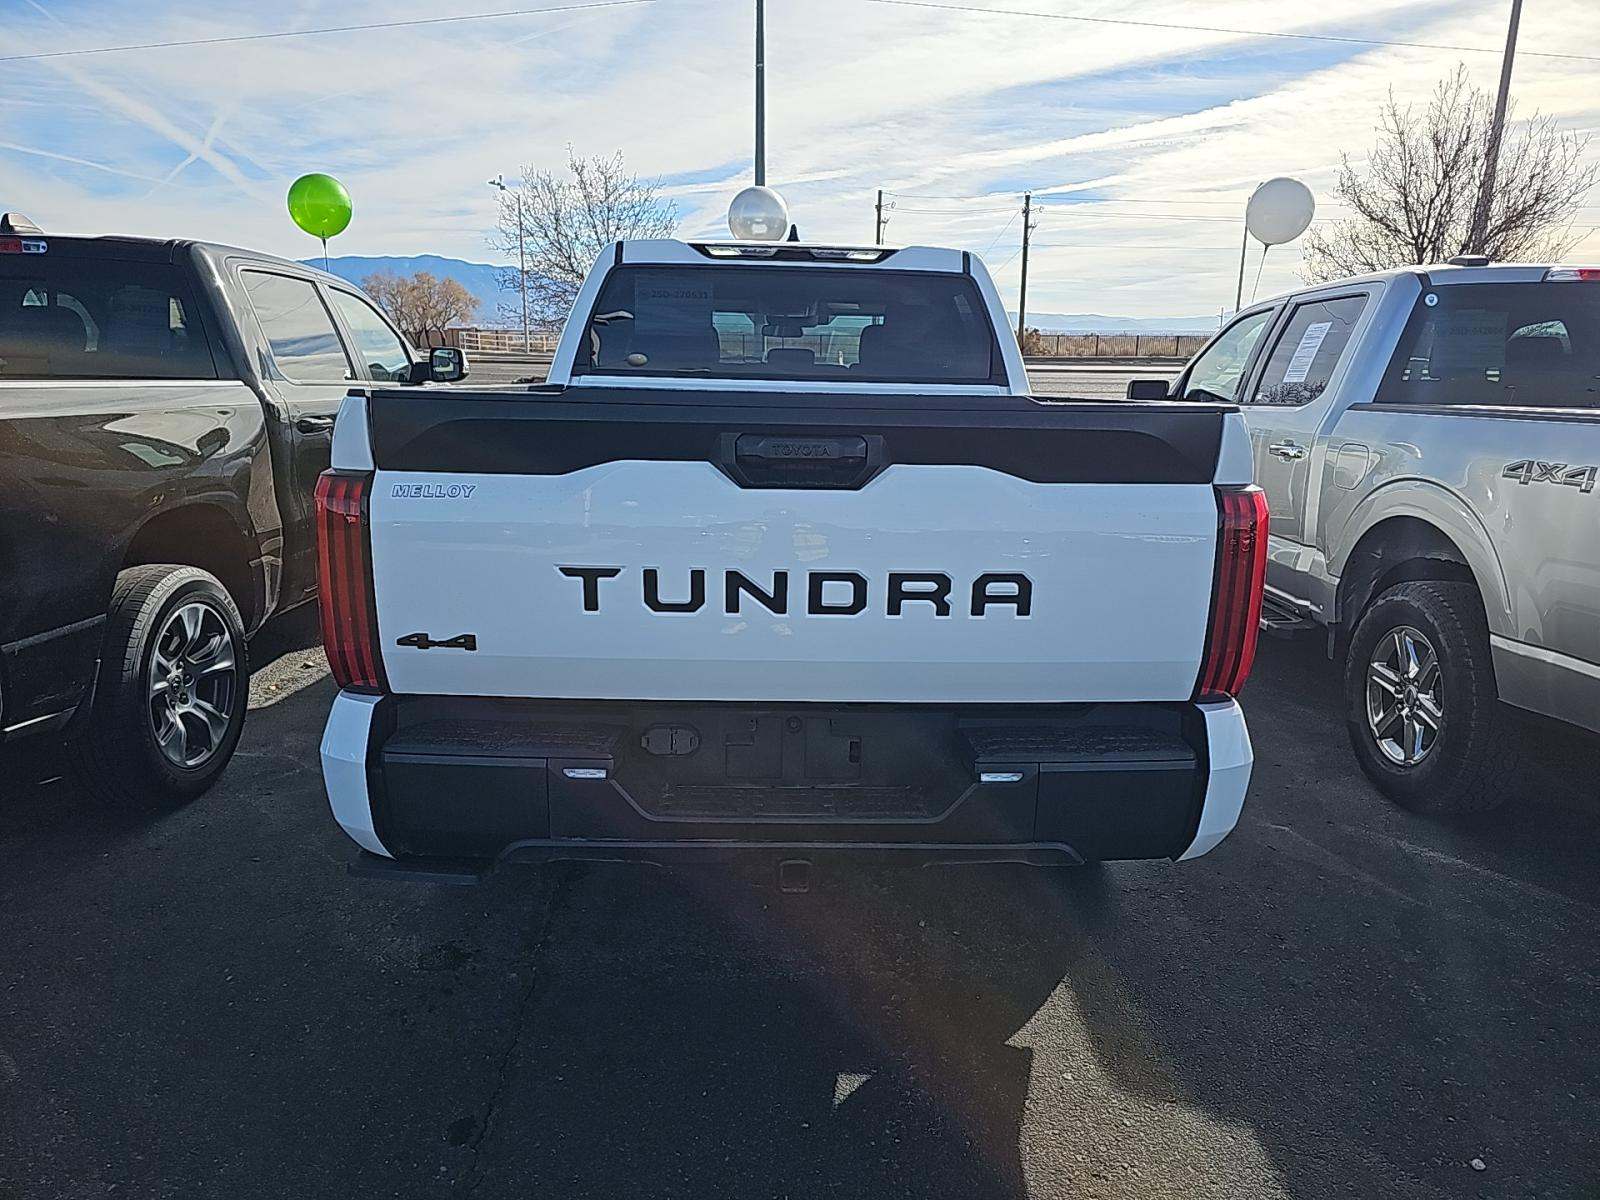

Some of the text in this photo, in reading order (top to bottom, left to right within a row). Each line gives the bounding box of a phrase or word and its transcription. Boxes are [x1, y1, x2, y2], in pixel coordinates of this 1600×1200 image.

[771, 444, 831, 456] TOYOTA
[391, 484, 476, 498] MELLOY
[558, 566, 1032, 617] TUNDRA
